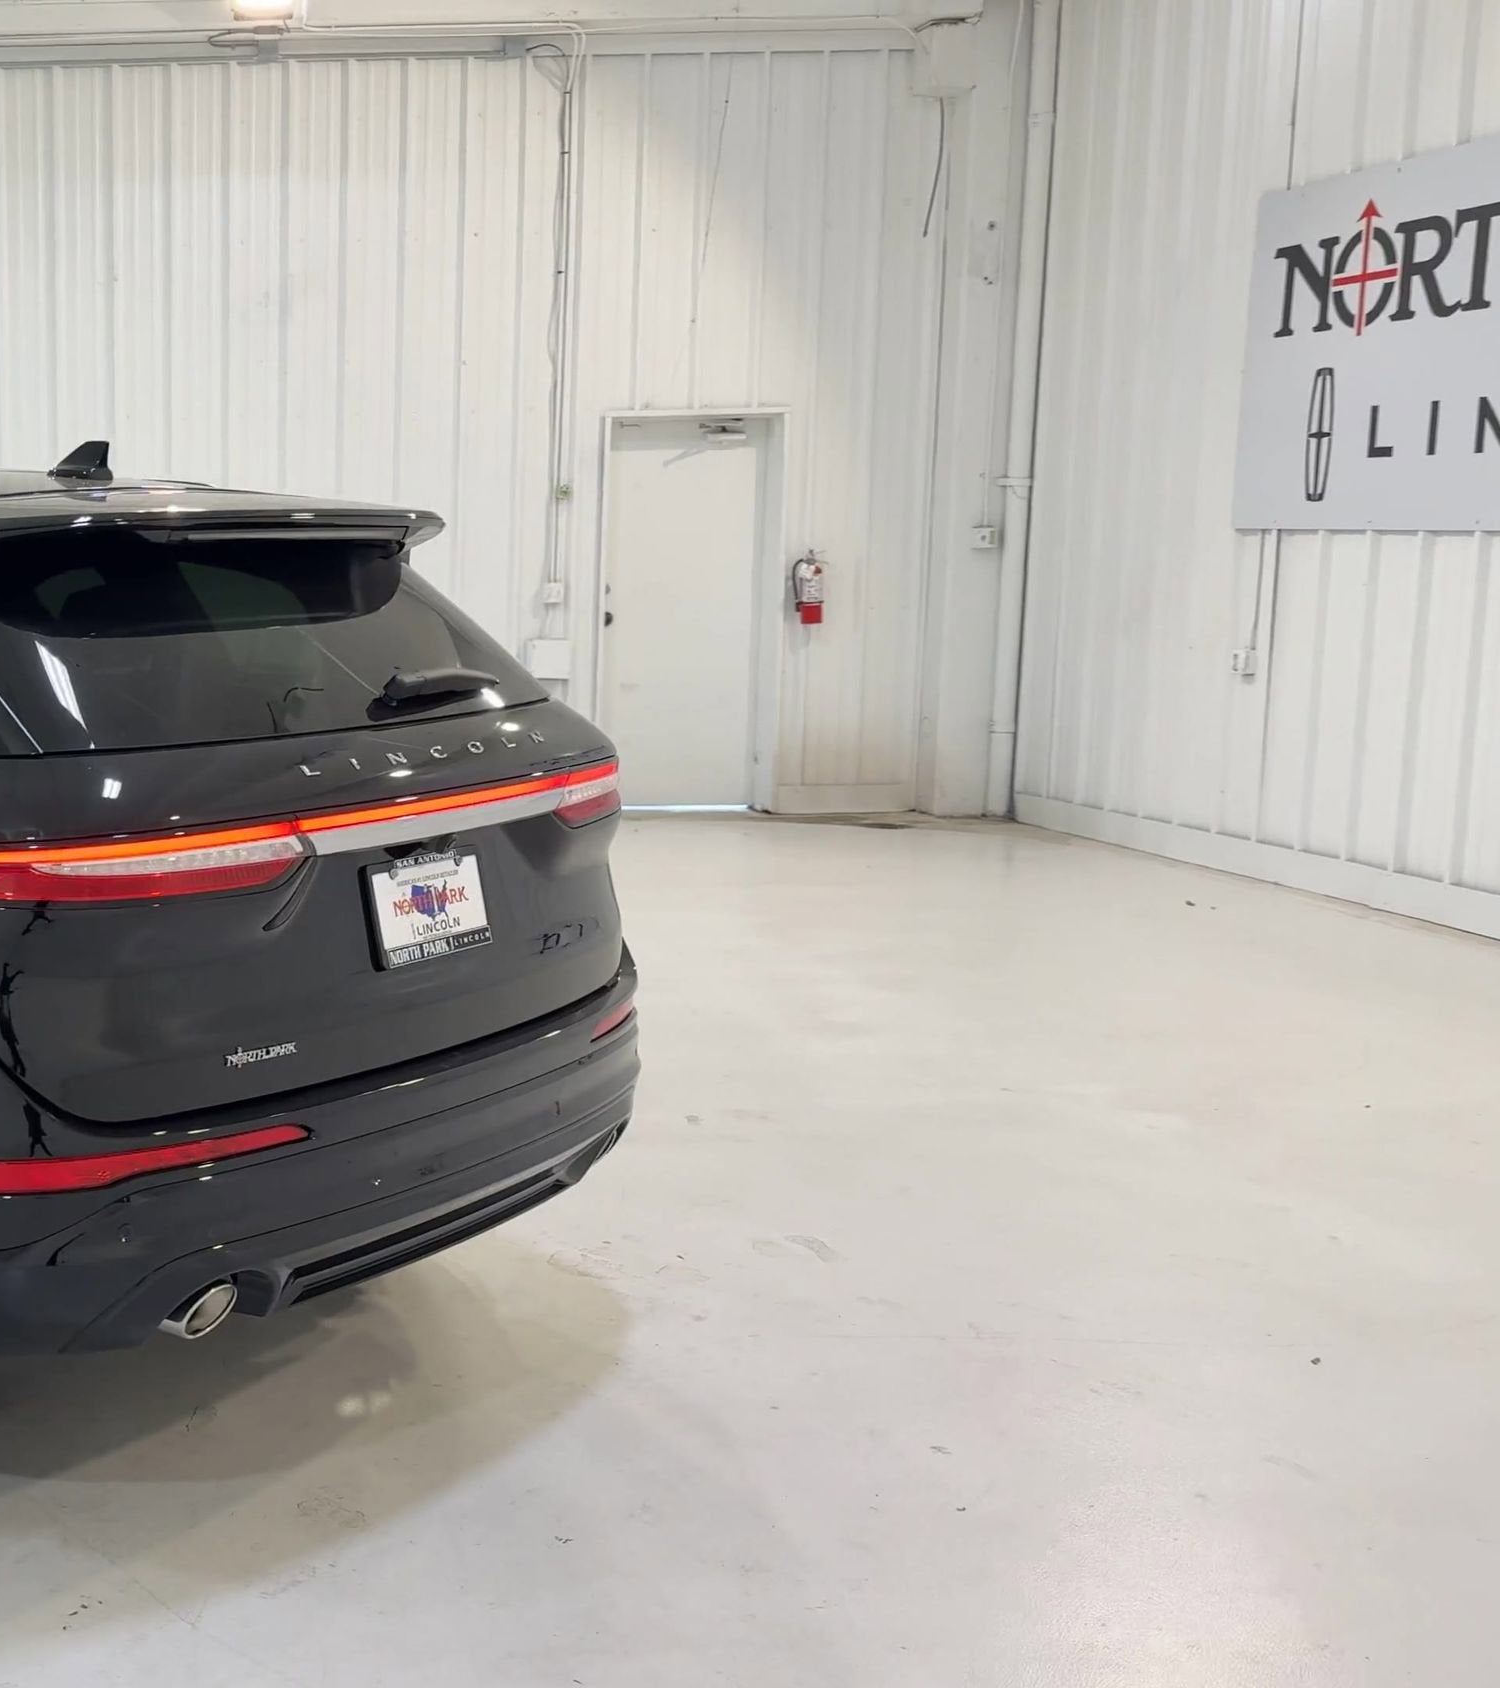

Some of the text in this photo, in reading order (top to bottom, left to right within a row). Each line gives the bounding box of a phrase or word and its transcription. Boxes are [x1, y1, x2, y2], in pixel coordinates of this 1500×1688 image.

[1274, 202, 1500, 337] NORT
[300, 730, 545, 777] LINCOLN
[396, 851, 454, 868] SAN ANTONIO
[393, 894, 432, 917] NORTH
[435, 886, 469, 907] PARK
[416, 916, 461, 936] LINCOLN
[389, 944, 422, 966] NORTH
[422, 938, 450, 957] PARK
[454, 931, 490, 946] LINCOLN
